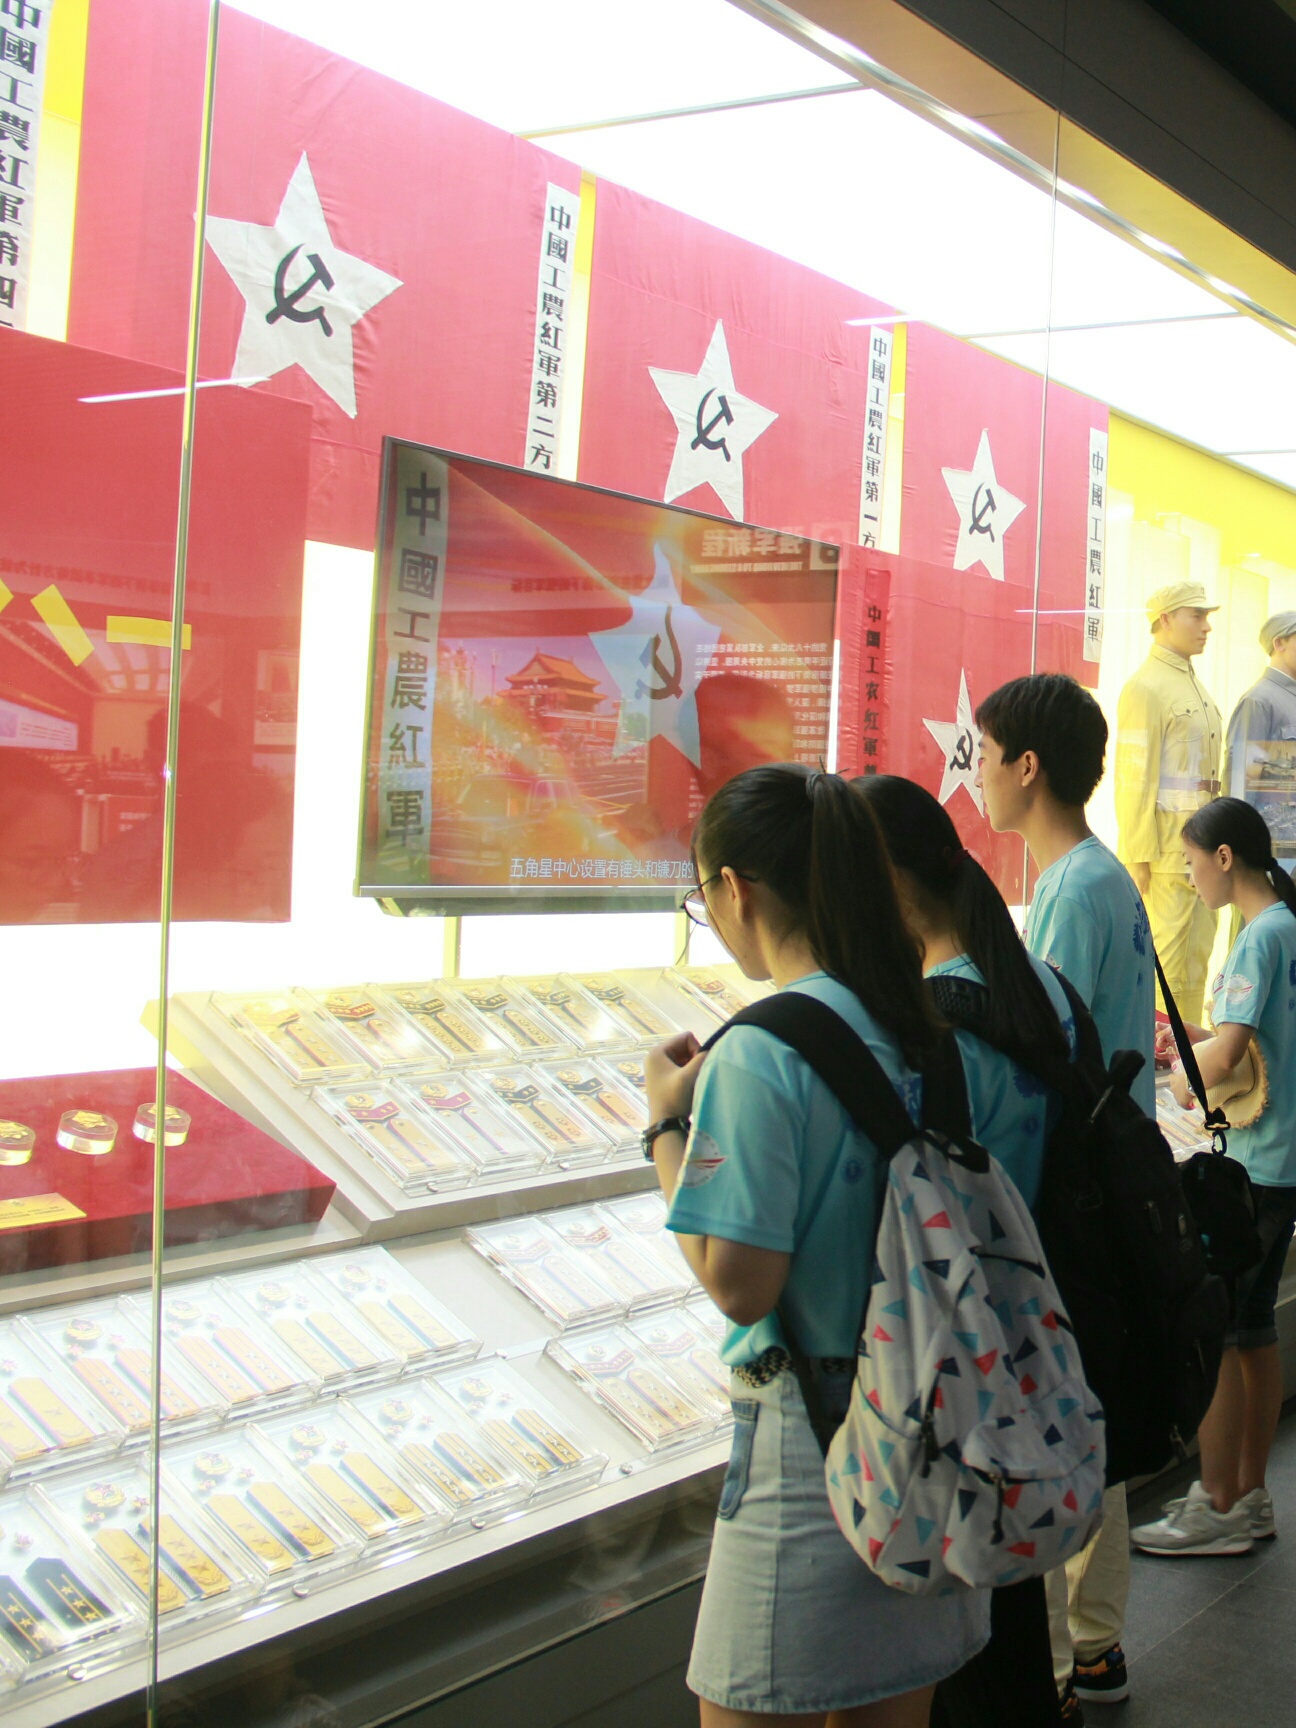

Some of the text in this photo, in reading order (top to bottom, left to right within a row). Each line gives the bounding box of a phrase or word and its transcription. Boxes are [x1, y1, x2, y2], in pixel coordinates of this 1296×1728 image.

[510, 857, 694, 879] 五角星中心设置有锤头和镰刀的
